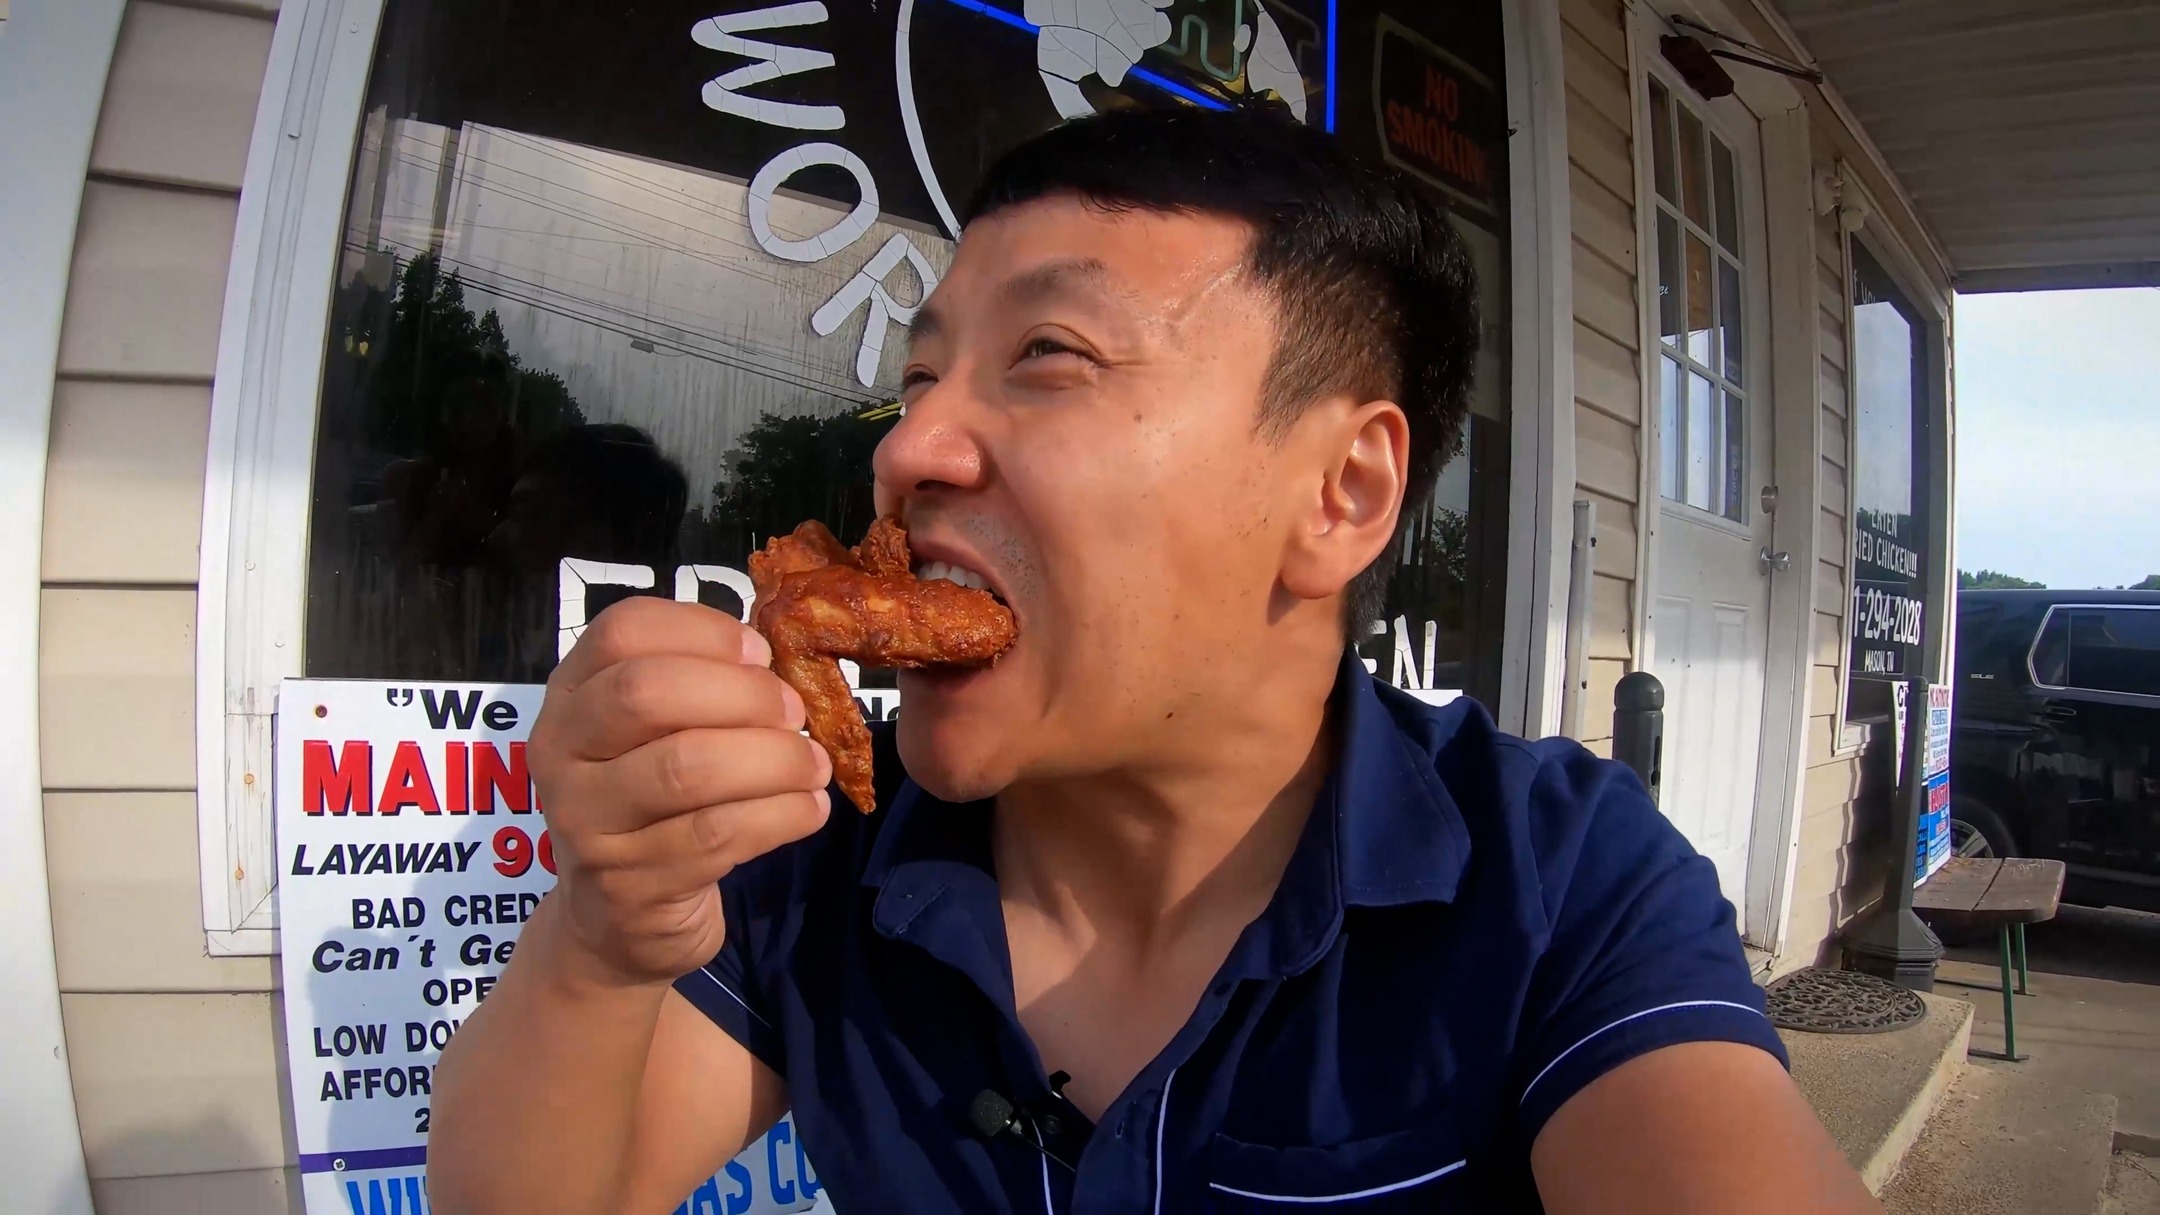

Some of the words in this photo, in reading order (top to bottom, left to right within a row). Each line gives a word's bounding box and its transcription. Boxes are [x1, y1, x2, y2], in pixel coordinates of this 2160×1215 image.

[1425, 64, 1459, 122] NO
[1876, 536, 1918, 579] CHICKEN!!!
[303, 740, 545, 816] MAIN
[291, 841, 482, 876] LAYAWAY
[352, 896, 426, 930] BAD
[444, 892, 549, 927] CRED
[313, 1023, 387, 1058] LOW
[405, 1019, 463, 1053] DO
[320, 1064, 436, 1102] AFFOR
